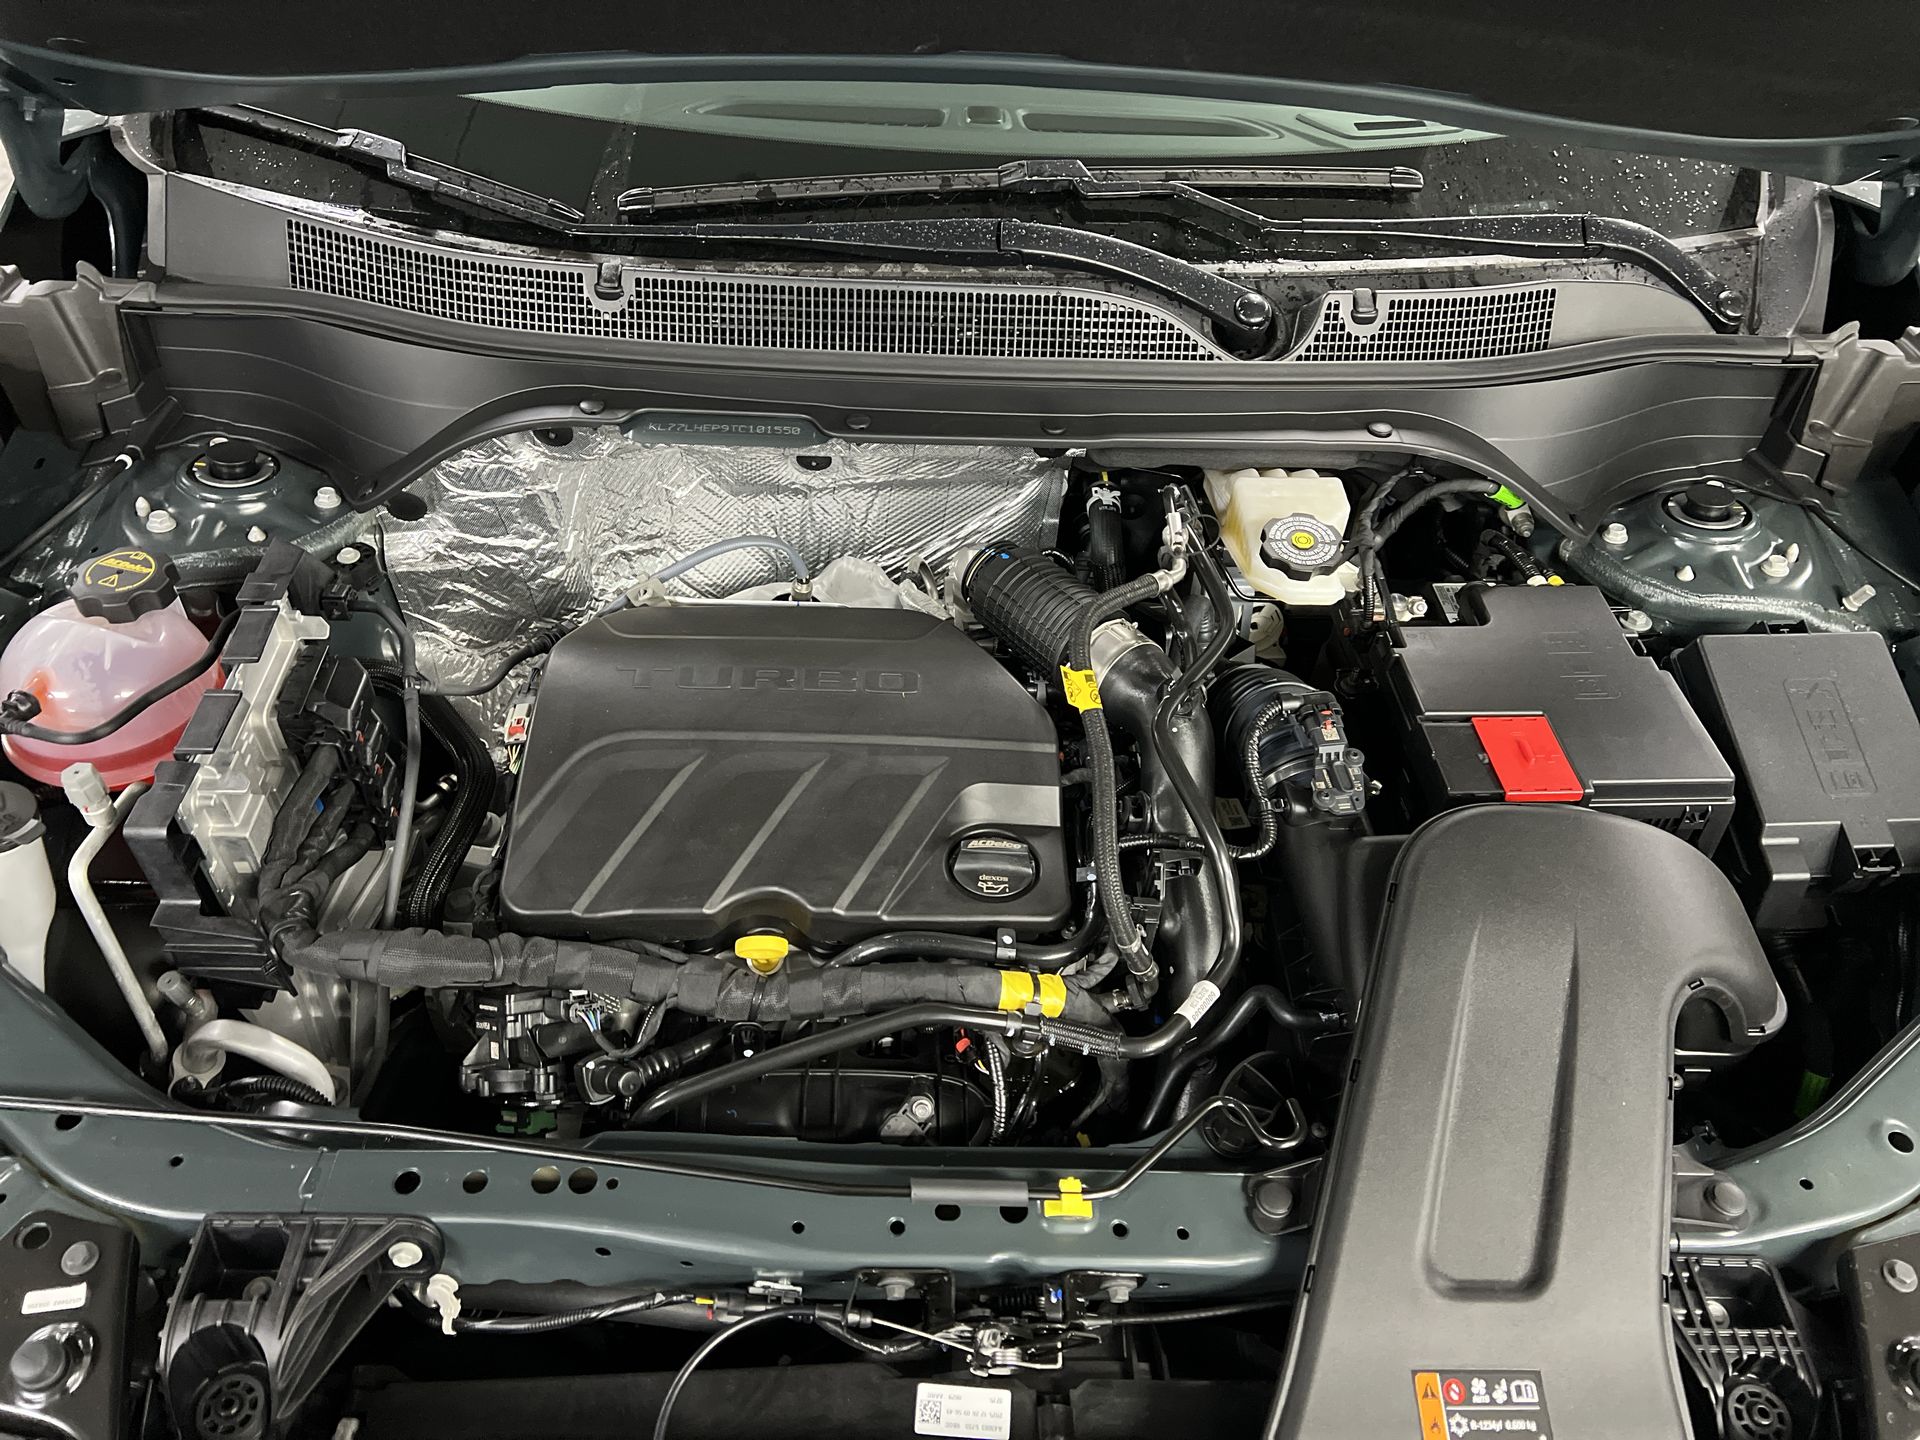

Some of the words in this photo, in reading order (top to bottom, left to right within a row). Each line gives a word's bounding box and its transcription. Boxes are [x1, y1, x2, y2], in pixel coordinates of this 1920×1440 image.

[649, 422, 801, 436] KL77LHEP9TC101550
[615, 664, 921, 696] TURBO
[967, 839, 1022, 849] ACDelco
[979, 874, 1009, 882] dexos
